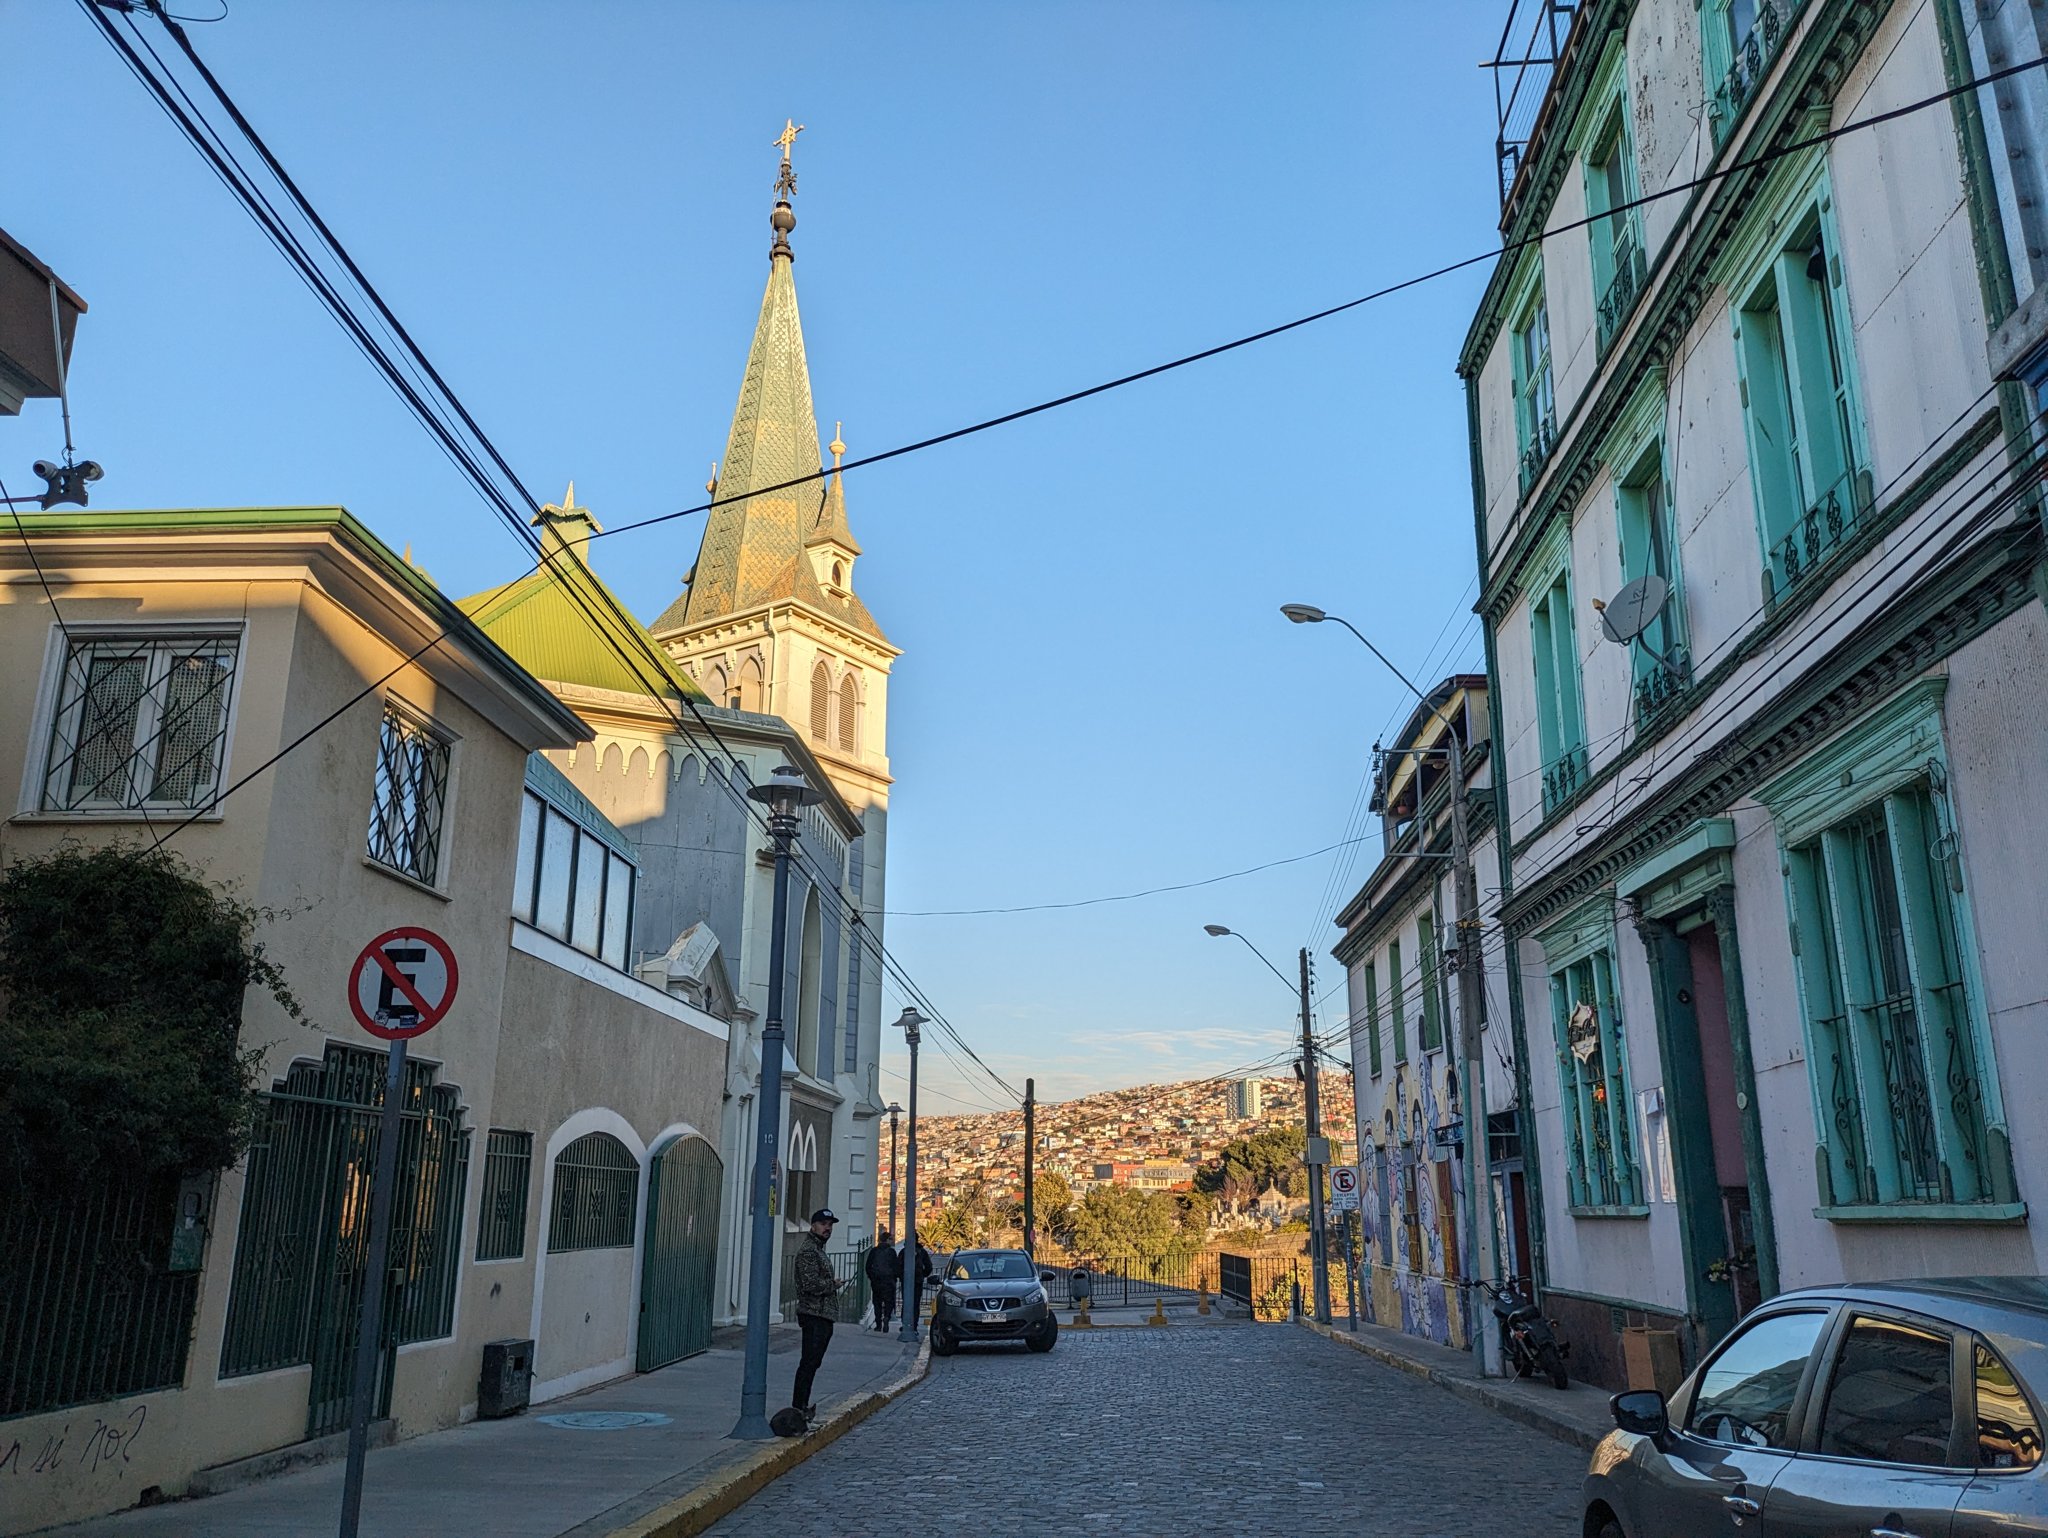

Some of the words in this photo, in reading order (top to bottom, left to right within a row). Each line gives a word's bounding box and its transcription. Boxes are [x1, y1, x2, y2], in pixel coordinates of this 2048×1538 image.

[378, 949, 427, 1020] E
[764, 1133, 774, 1144] 10
[1340, 1173, 1349, 1188] E
